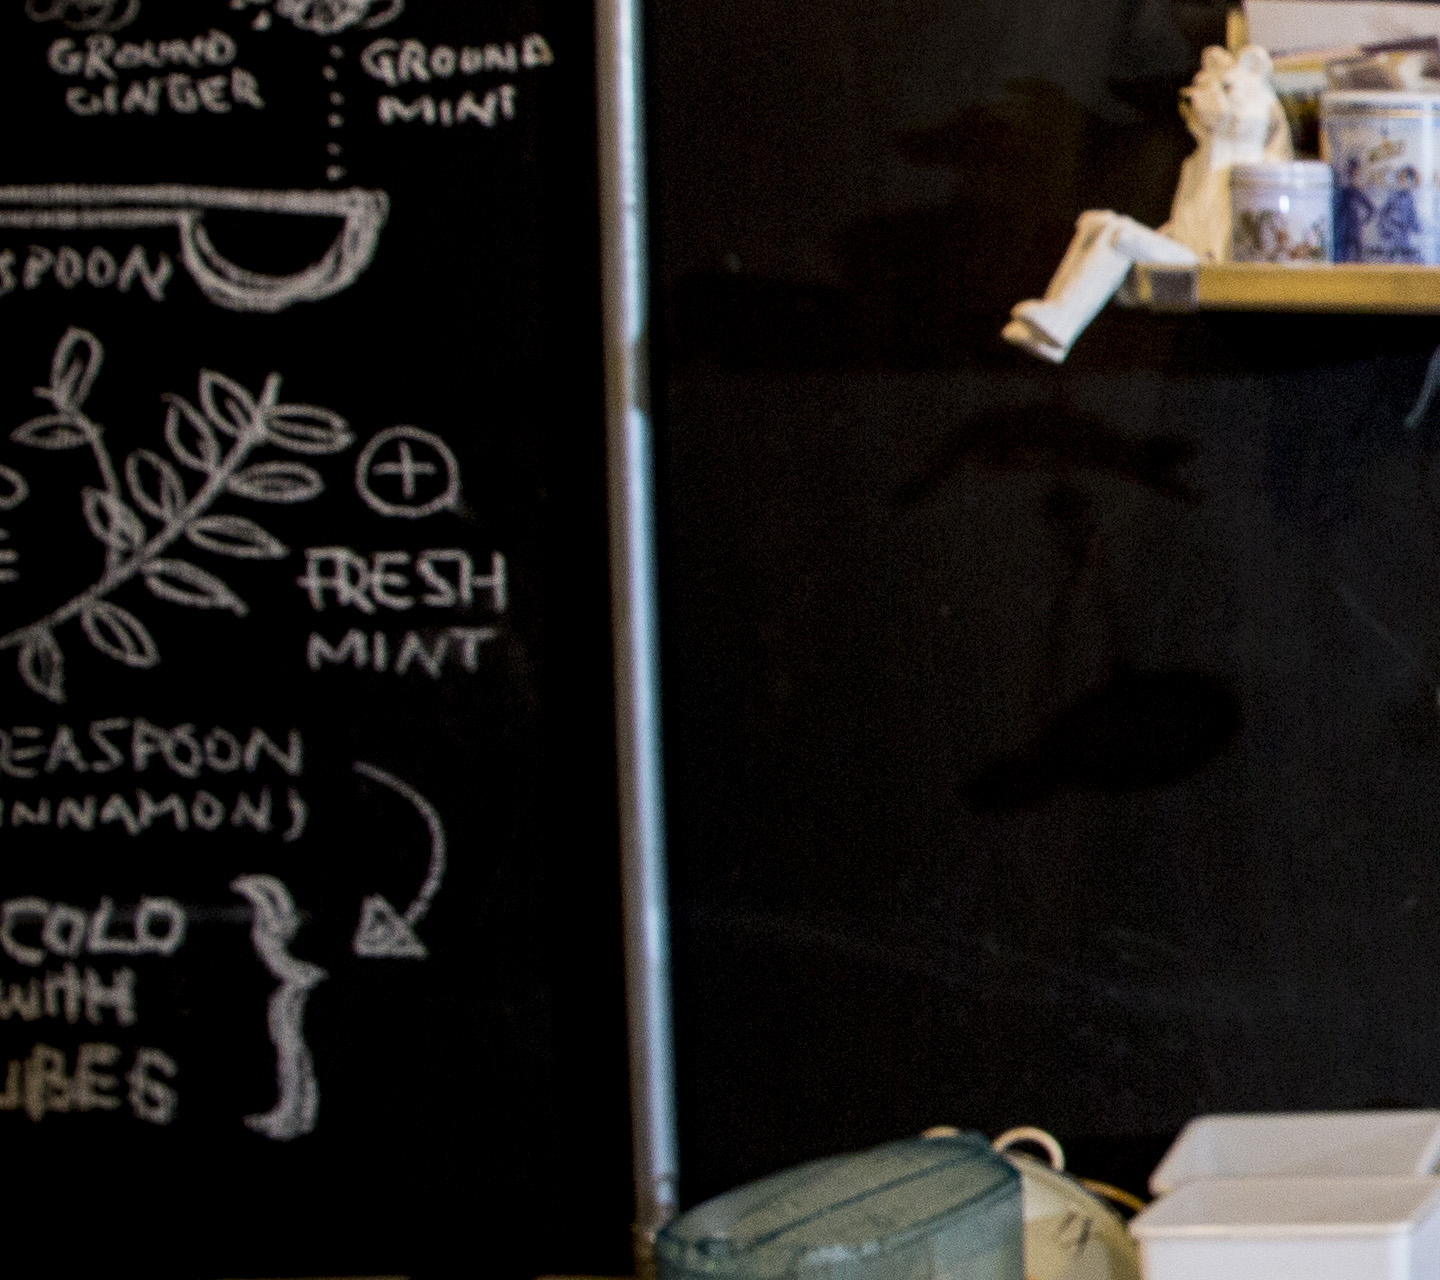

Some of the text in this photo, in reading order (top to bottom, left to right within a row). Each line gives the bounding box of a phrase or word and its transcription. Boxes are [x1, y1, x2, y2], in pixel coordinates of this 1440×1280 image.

[360, 32, 556, 84] GROUND
[376, 84, 520, 128] MINT
[297, 545, 508, 614] FRESH
[306, 625, 498, 678] MINT
[0, 892, 190, 968] COLD
